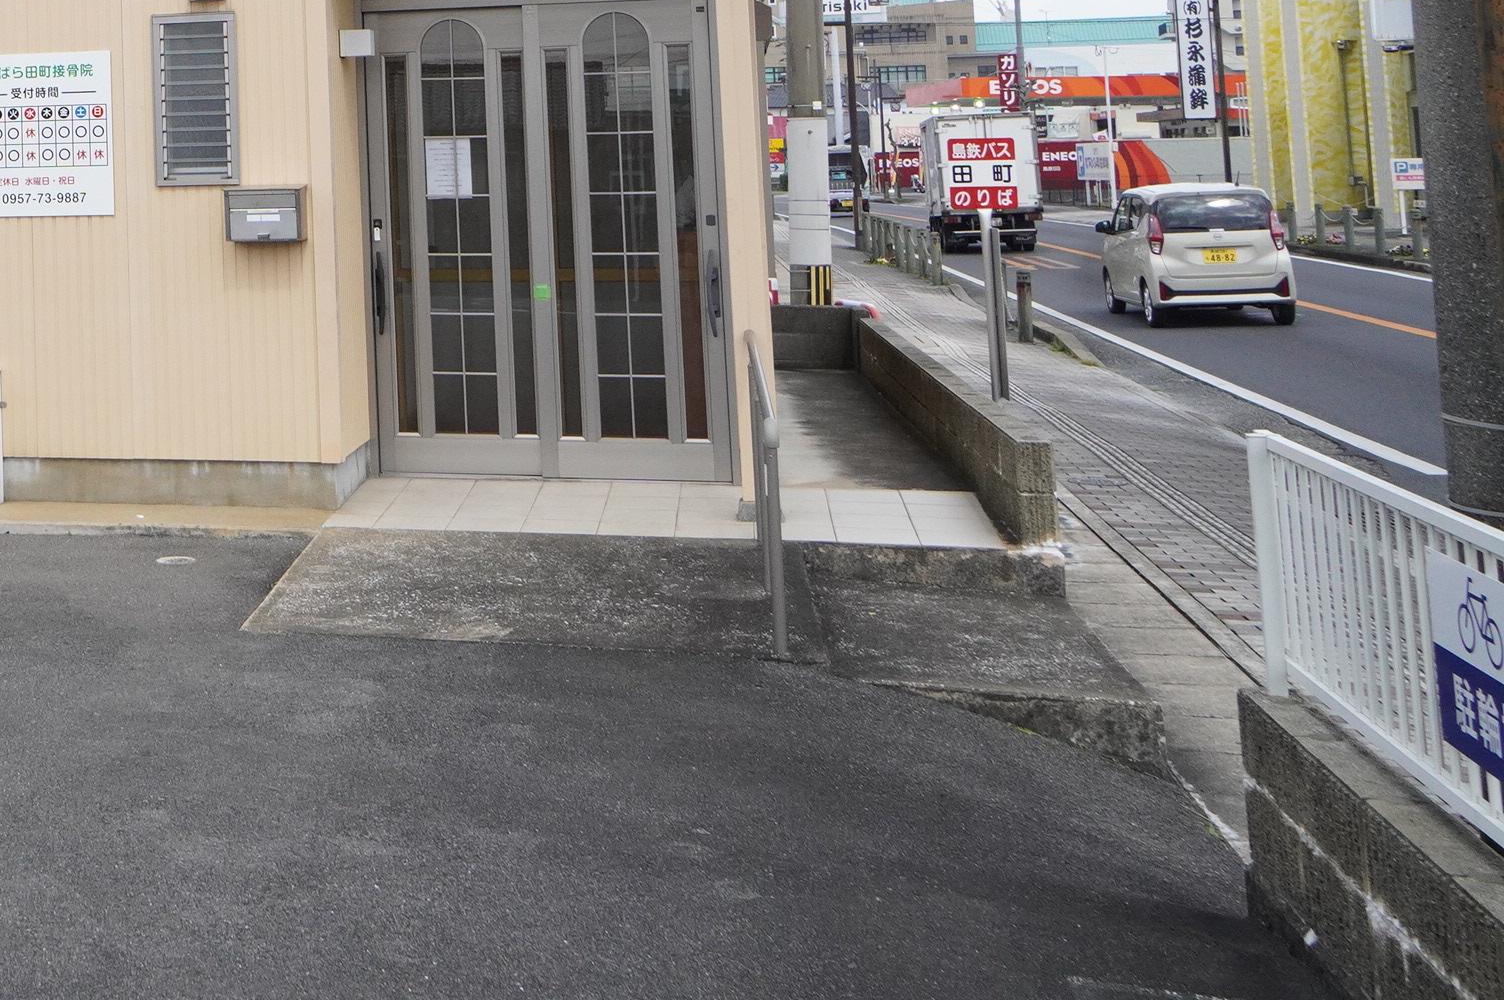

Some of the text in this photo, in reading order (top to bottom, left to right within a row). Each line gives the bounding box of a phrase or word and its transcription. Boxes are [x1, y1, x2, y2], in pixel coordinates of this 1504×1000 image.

[823, 0, 867, 12] riski
[989, 79, 1063, 95] EOS
[1001, 55, 1015, 113] ガソリ
[11, 86, 59, 100] 受付時間
[58, 107, 69, 118] 金
[25, 128, 36, 138] 休
[26, 149, 105, 161] 休 休 休
[952, 142, 1012, 159] 島鉄バス
[1042, 151, 1077, 162] ENEO
[24, 176, 75, 186] 水曜日・祝日
[2, 192, 87, 204] 0957-73-9887
[955, 189, 1014, 206] のりば
[1452, 672, 1504, 759] 駐輪
